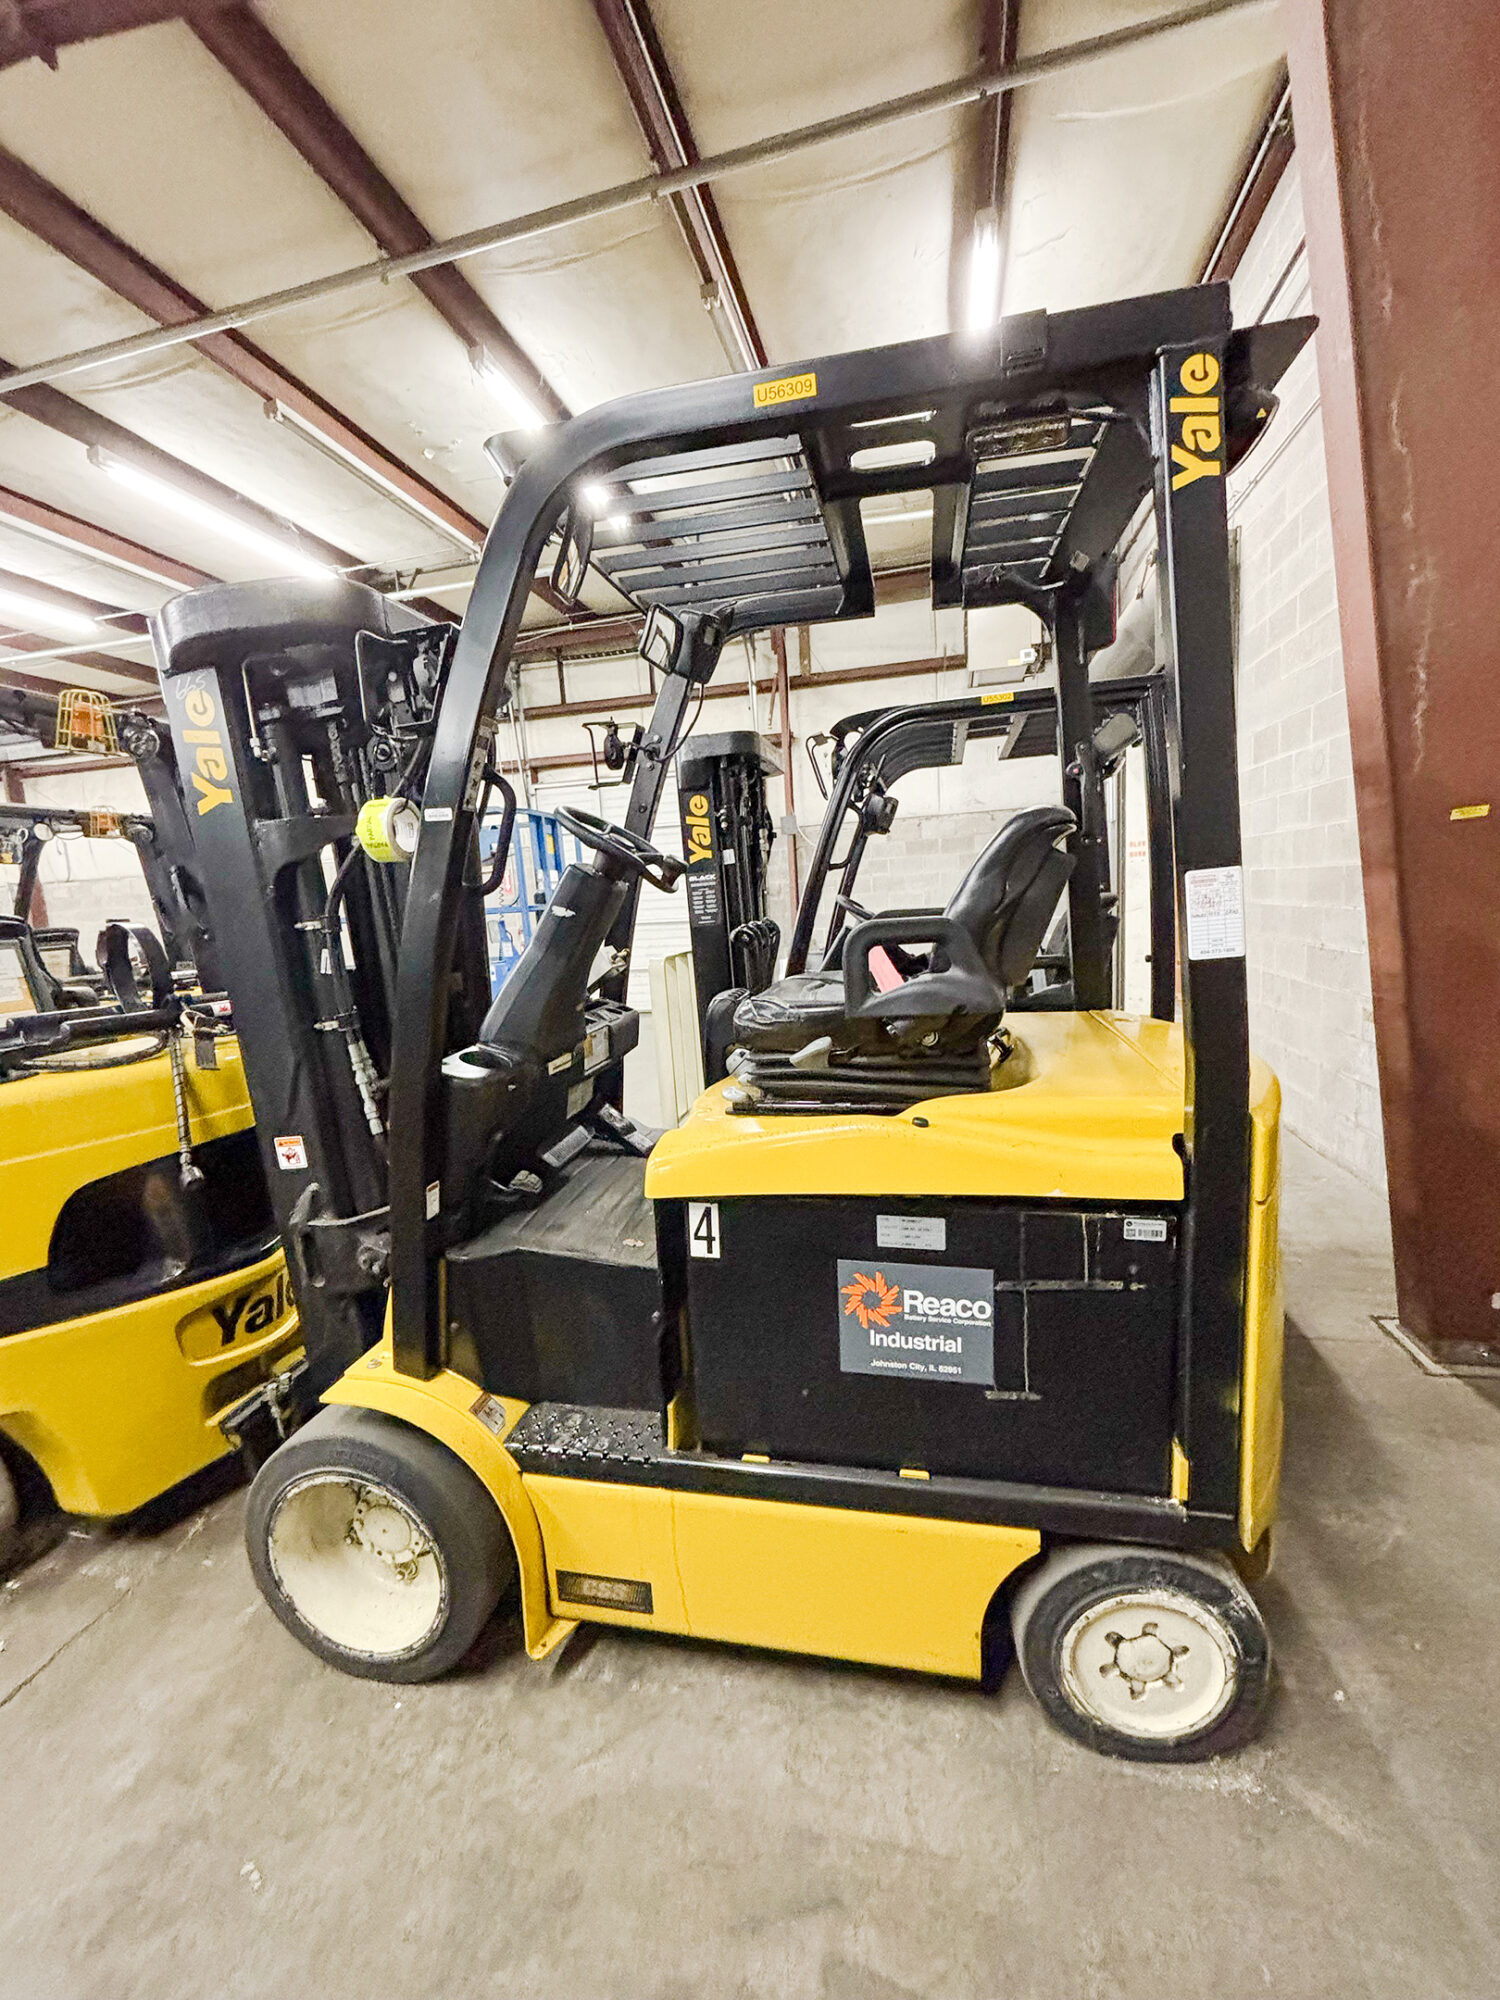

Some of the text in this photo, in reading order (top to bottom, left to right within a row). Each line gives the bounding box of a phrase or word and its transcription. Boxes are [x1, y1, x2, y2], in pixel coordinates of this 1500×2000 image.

[757, 378, 813, 402] U56309
[1169, 353, 1221, 491] Yale
[182, 689, 234, 816] Yale
[685, 794, 713, 864] Yale
[694, 1206, 716, 1254] 4
[903, 1290, 992, 1319] Reaco
[904, 1314, 991, 1327] Battery Service Corporation
[869, 1329, 962, 1354] Industrial
[870, 1359, 907, 1370] Johnston
[909, 1362, 927, 1373] City,
[929, 1364, 937, 1372] IL
